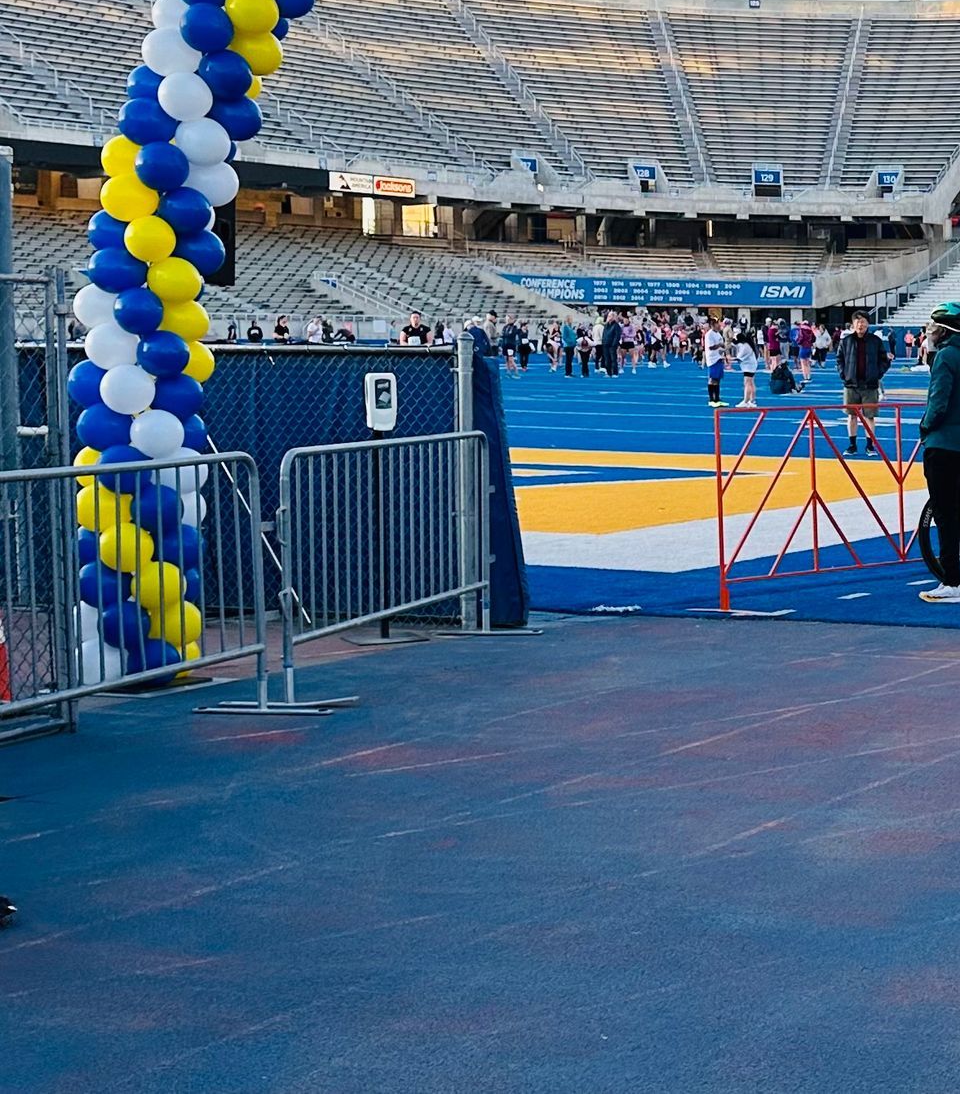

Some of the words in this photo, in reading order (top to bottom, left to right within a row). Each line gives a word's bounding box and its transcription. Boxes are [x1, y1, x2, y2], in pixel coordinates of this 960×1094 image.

[760, 174, 774, 182] 129
[882, 175, 896, 184] 130
[520, 277, 576, 289] CONFERENCE
[760, 285, 806, 299] ISMI
